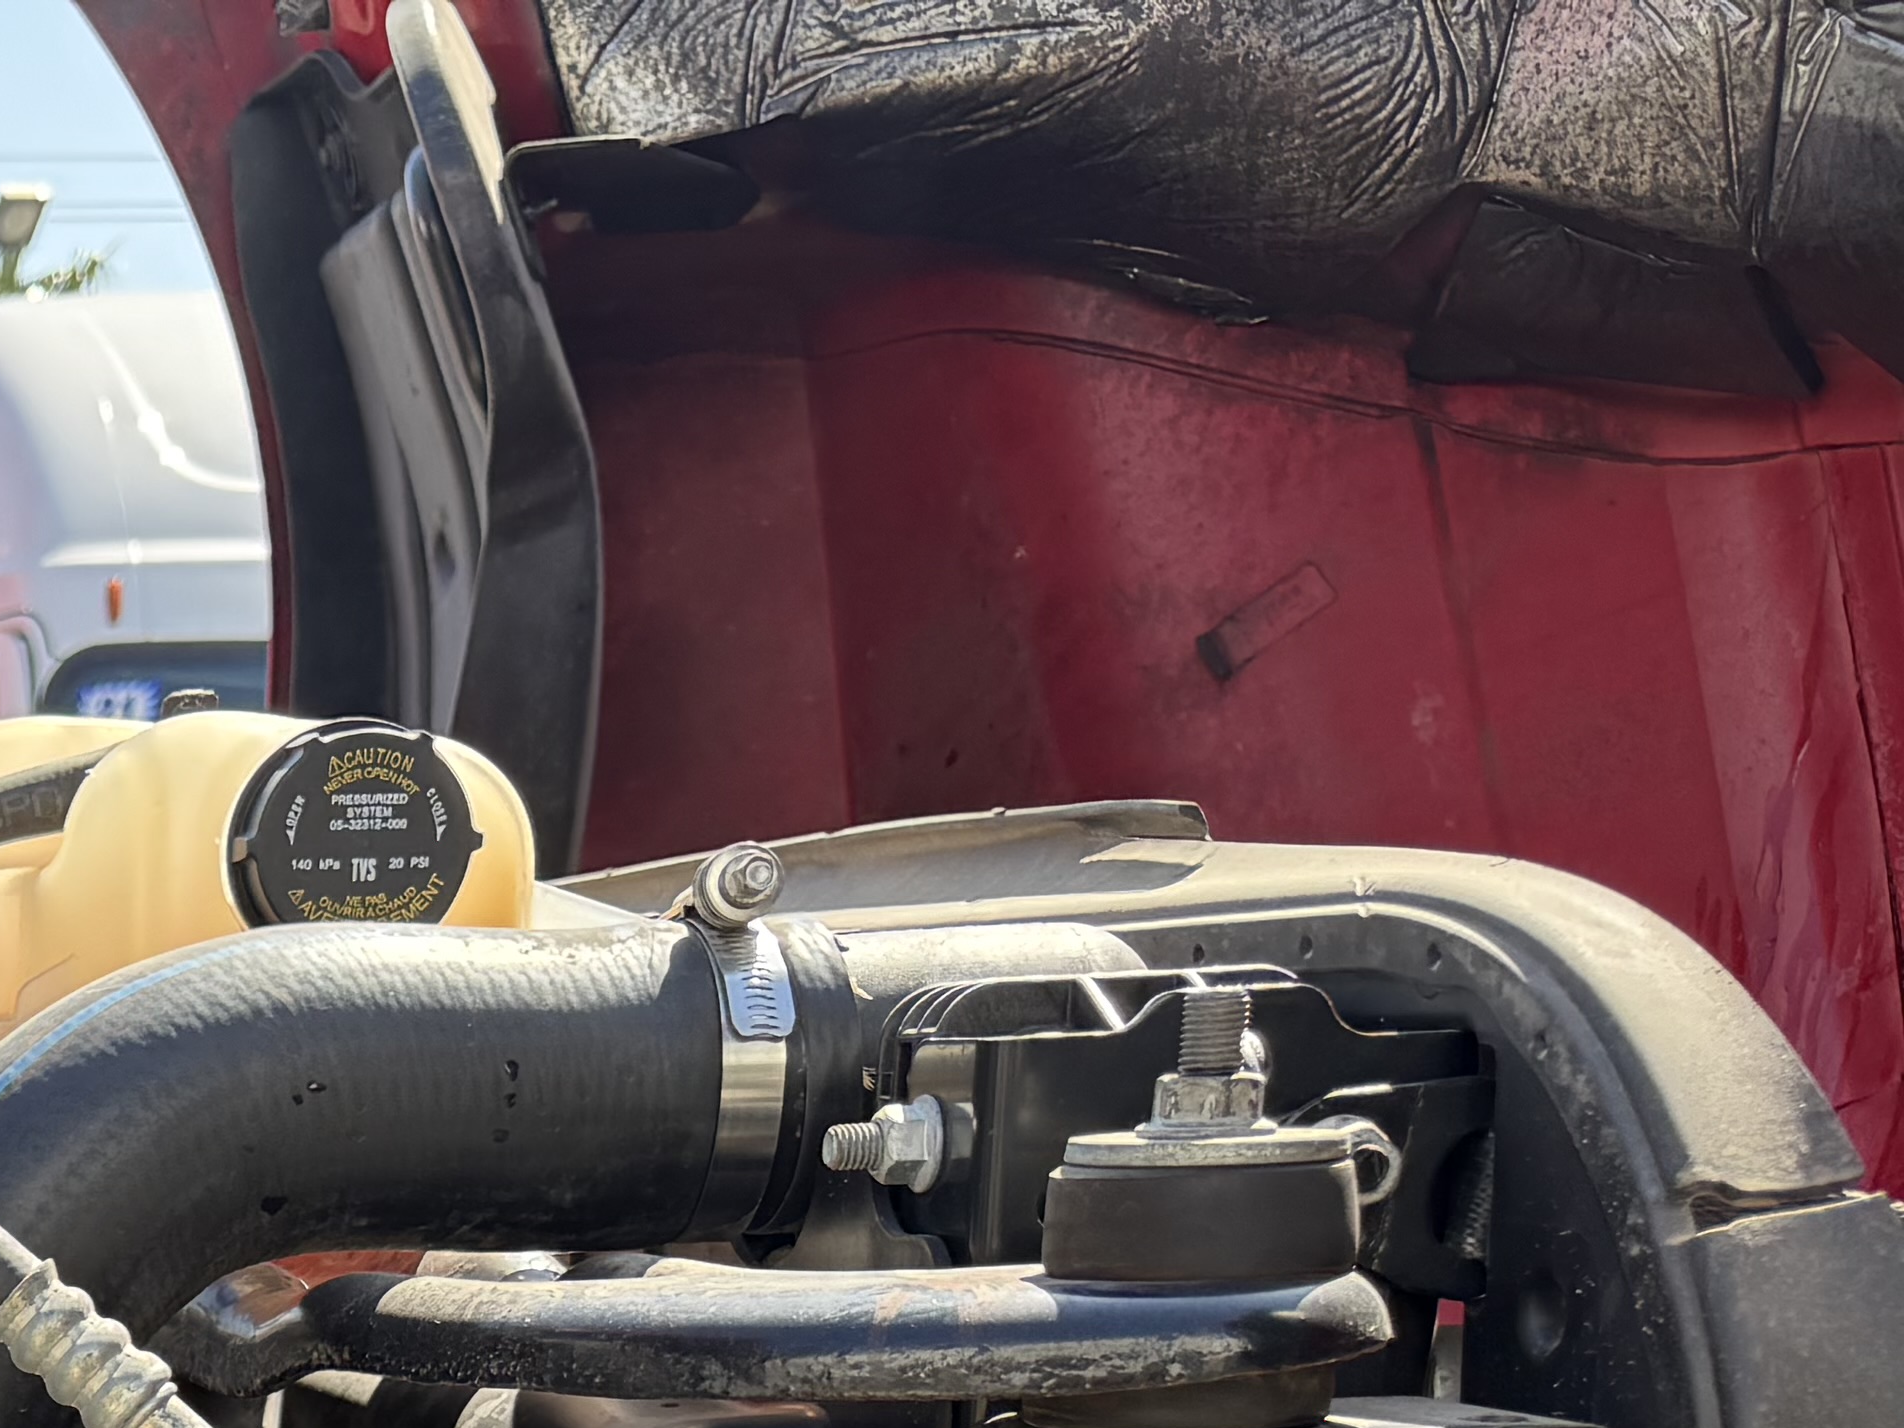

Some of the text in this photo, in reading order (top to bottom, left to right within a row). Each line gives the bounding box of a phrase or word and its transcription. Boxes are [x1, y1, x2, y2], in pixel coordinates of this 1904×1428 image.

[344, 747, 415, 773] CAUTION
[322, 767, 421, 796] NEVER OPEN HOT
[331, 792, 409, 806] PRESSURIZED
[346, 806, 392, 818] SYSTEM
[292, 858, 341, 871] 140 kPa
[351, 857, 378, 883] TVS
[388, 856, 430, 870] 20 PSI
[319, 896, 364, 918] OUVRIR
[376, 886, 417, 917] CHAUD
[344, 895, 363, 907] NE
